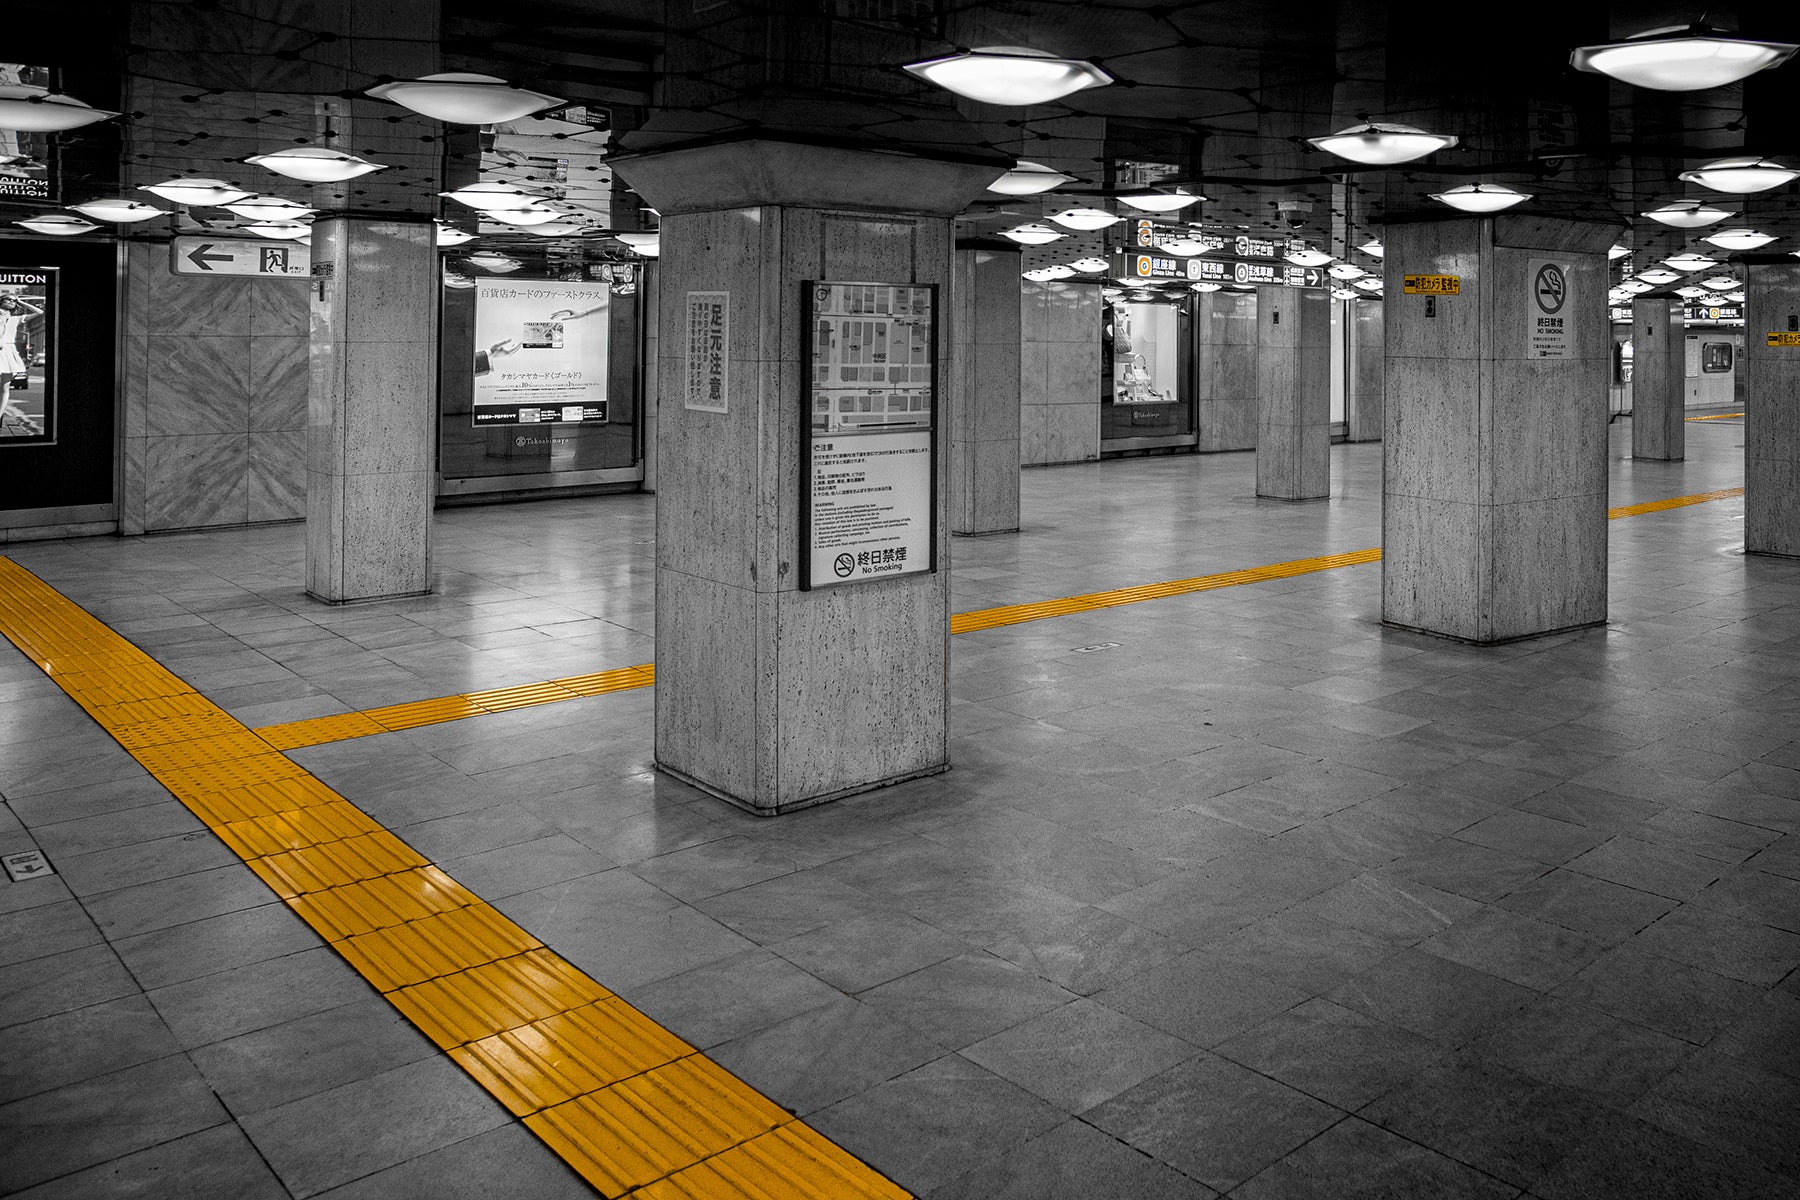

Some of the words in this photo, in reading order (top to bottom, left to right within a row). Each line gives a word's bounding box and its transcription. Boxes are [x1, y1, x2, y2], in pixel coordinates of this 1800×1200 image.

[1152, 258, 1177, 270] 銀座線
[1201, 262, 1225, 274] 東西線
[481, 288, 605, 301] 百貨店カードのファーストクラス。
[1537, 317, 1564, 328] 終日禁煙
[710, 304, 723, 400] 足元注意
[526, 437, 569, 445] Takashimaya
[858, 547, 907, 567] 終日禁煙
[874, 563, 903, 573] Smoking
